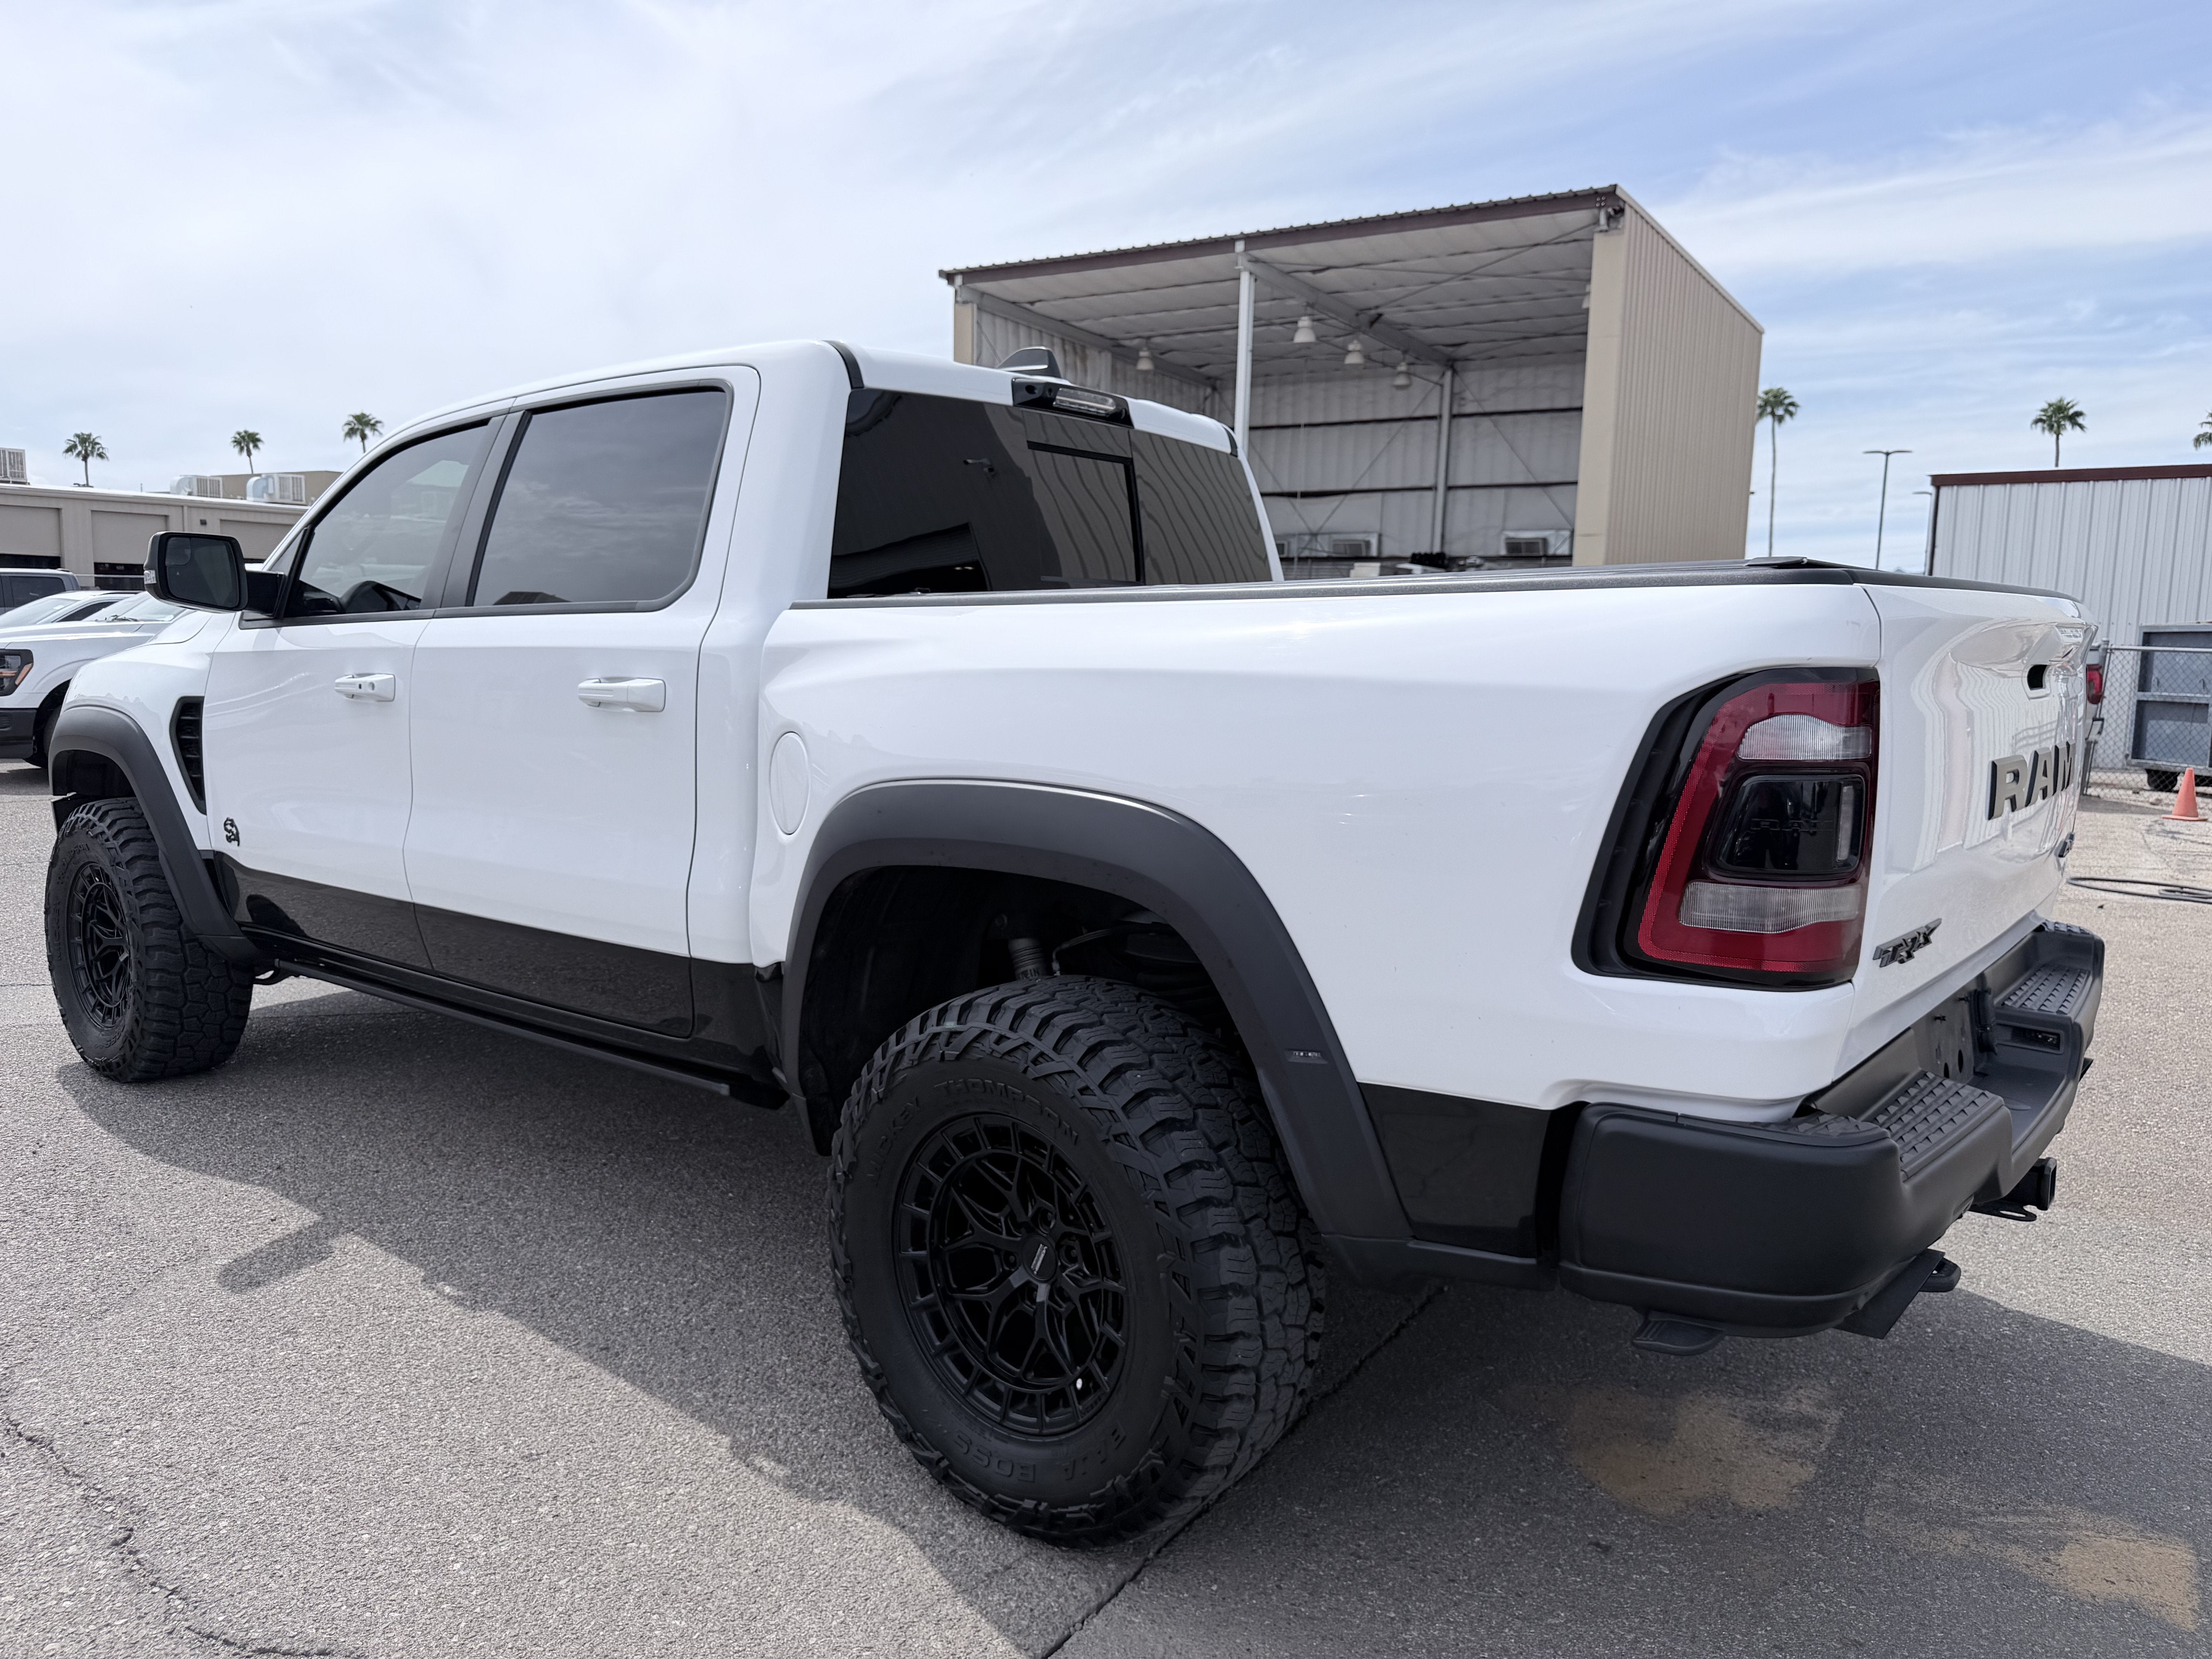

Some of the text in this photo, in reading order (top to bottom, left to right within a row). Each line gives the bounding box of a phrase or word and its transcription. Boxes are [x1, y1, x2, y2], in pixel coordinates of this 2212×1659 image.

[1985, 740, 2076, 821] RAM
[1872, 918, 1942, 968] TRX
[933, 1078, 1079, 1146] THOMPSON
[949, 1427, 1037, 1484] BOSS
